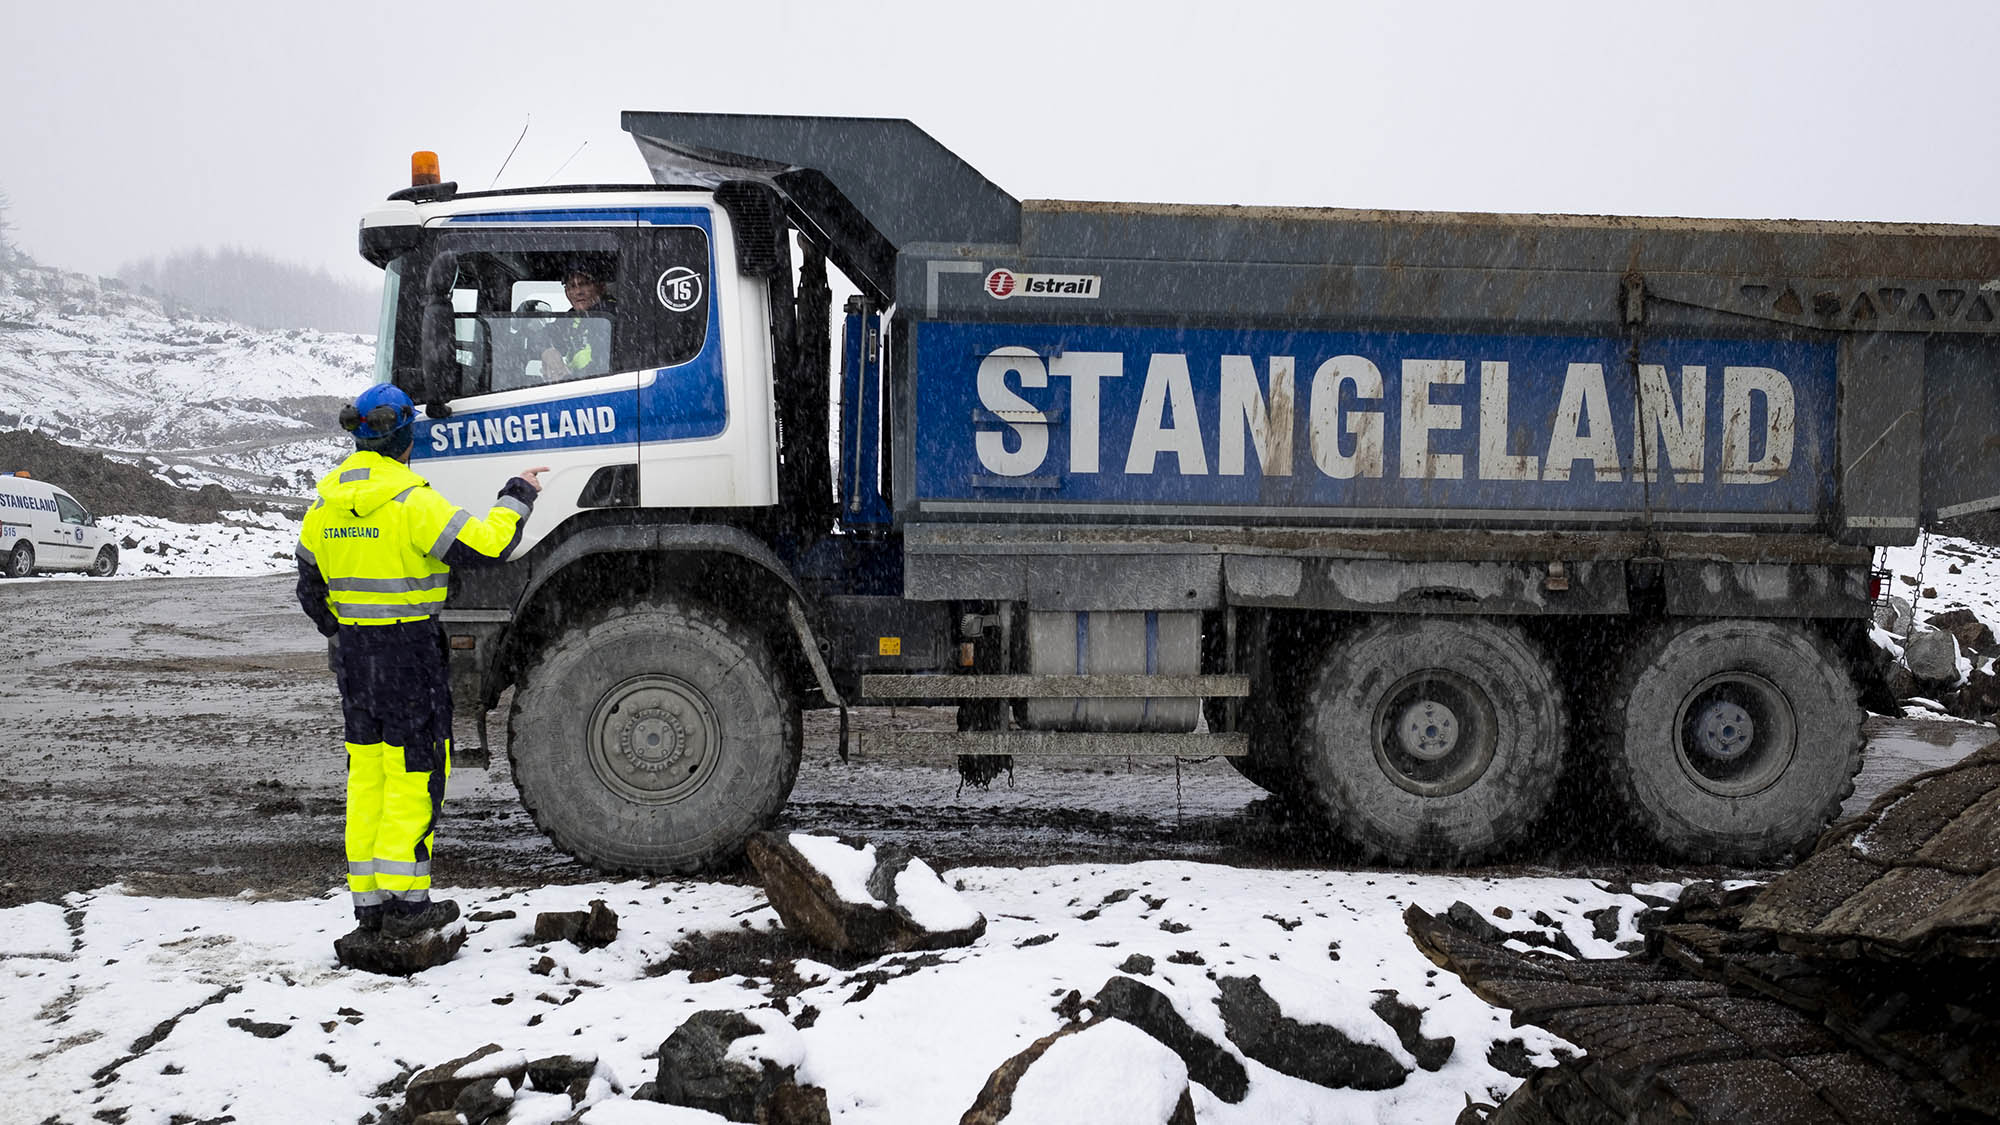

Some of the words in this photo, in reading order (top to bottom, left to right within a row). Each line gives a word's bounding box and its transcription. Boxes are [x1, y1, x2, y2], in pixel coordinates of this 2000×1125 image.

[666, 273, 700, 300] TS
[1024, 277, 1093, 294] Istrail
[974, 346, 1796, 485] STANGELAND
[430, 406, 616, 452] STANGELAND
[0, 493, 57, 512] STANGELAND
[3, 526, 17, 537] 515
